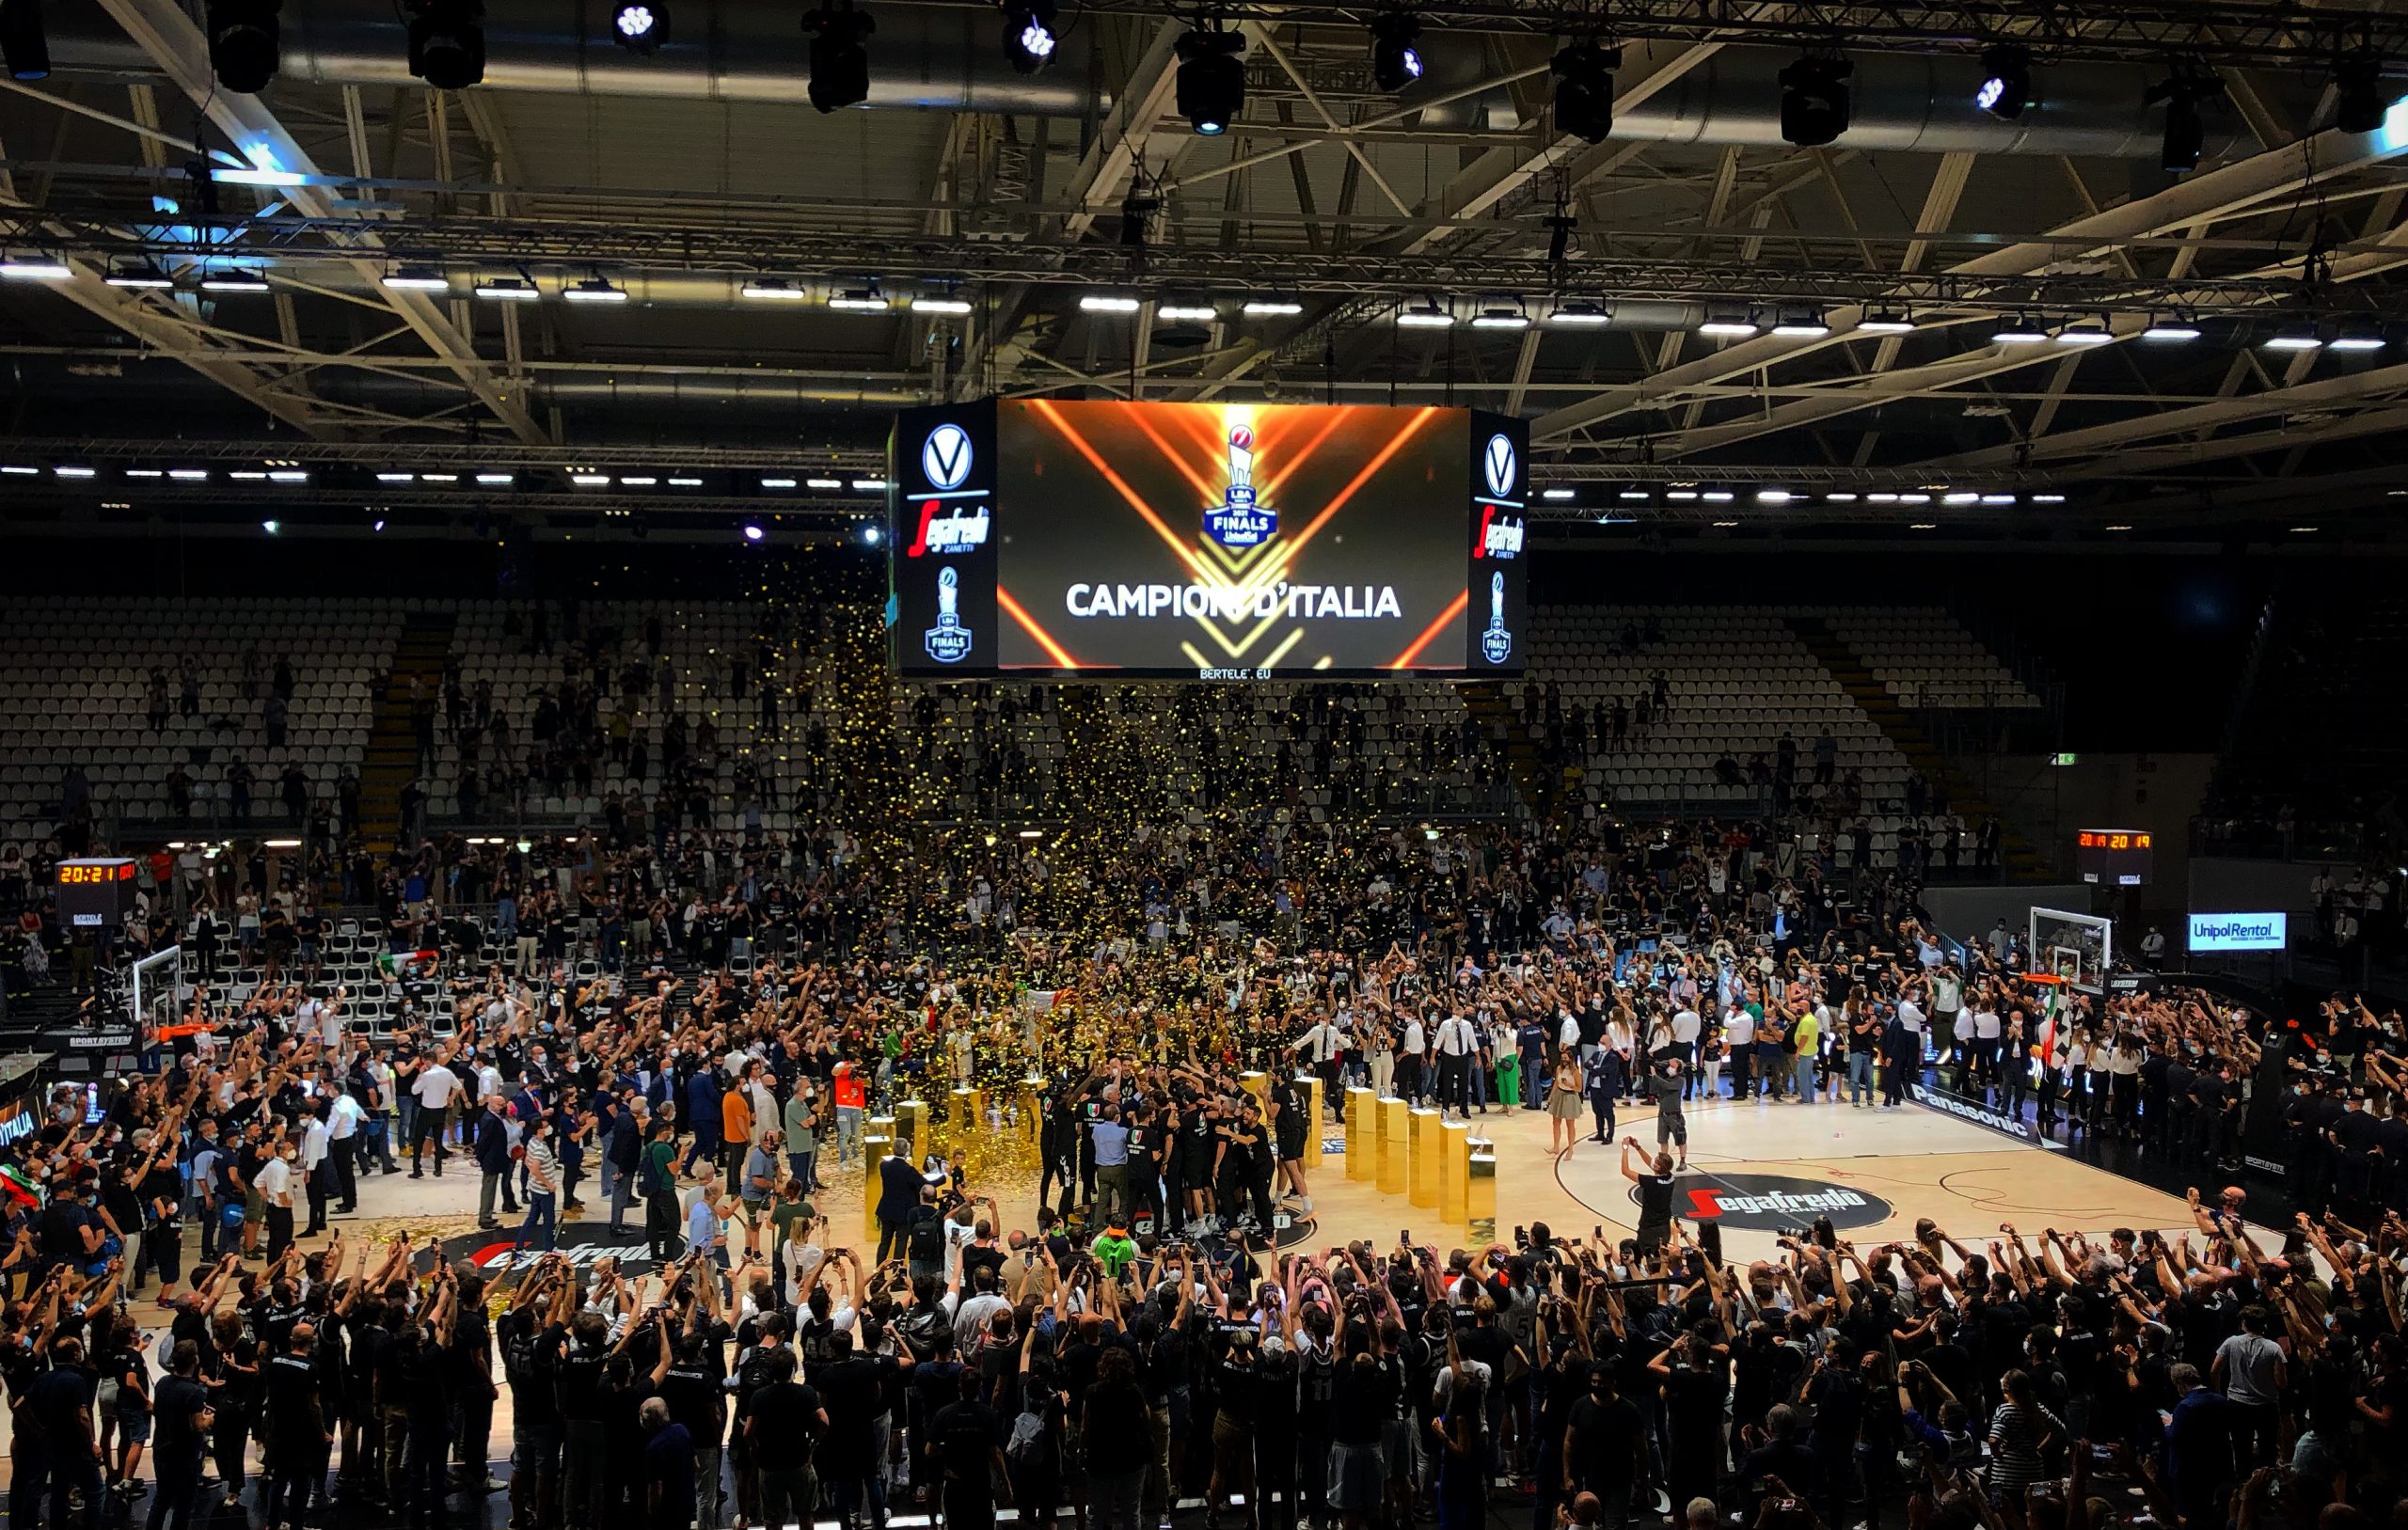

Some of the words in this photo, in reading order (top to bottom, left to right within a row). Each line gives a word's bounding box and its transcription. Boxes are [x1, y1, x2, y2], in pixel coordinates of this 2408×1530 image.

[1213, 516, 1268, 530] FINALS
[1254, 581, 1402, 619] D'ITALIA
[932, 637, 966, 648] FINALS
[2080, 833, 2092, 846] 20
[2111, 835, 2128, 848] 20
[2136, 835, 2150, 848] 19
[61, 866, 114, 883] 20:21
[2194, 923, 2273, 941] UnipolRental
[1910, 1083, 2029, 1137] Panasonic
